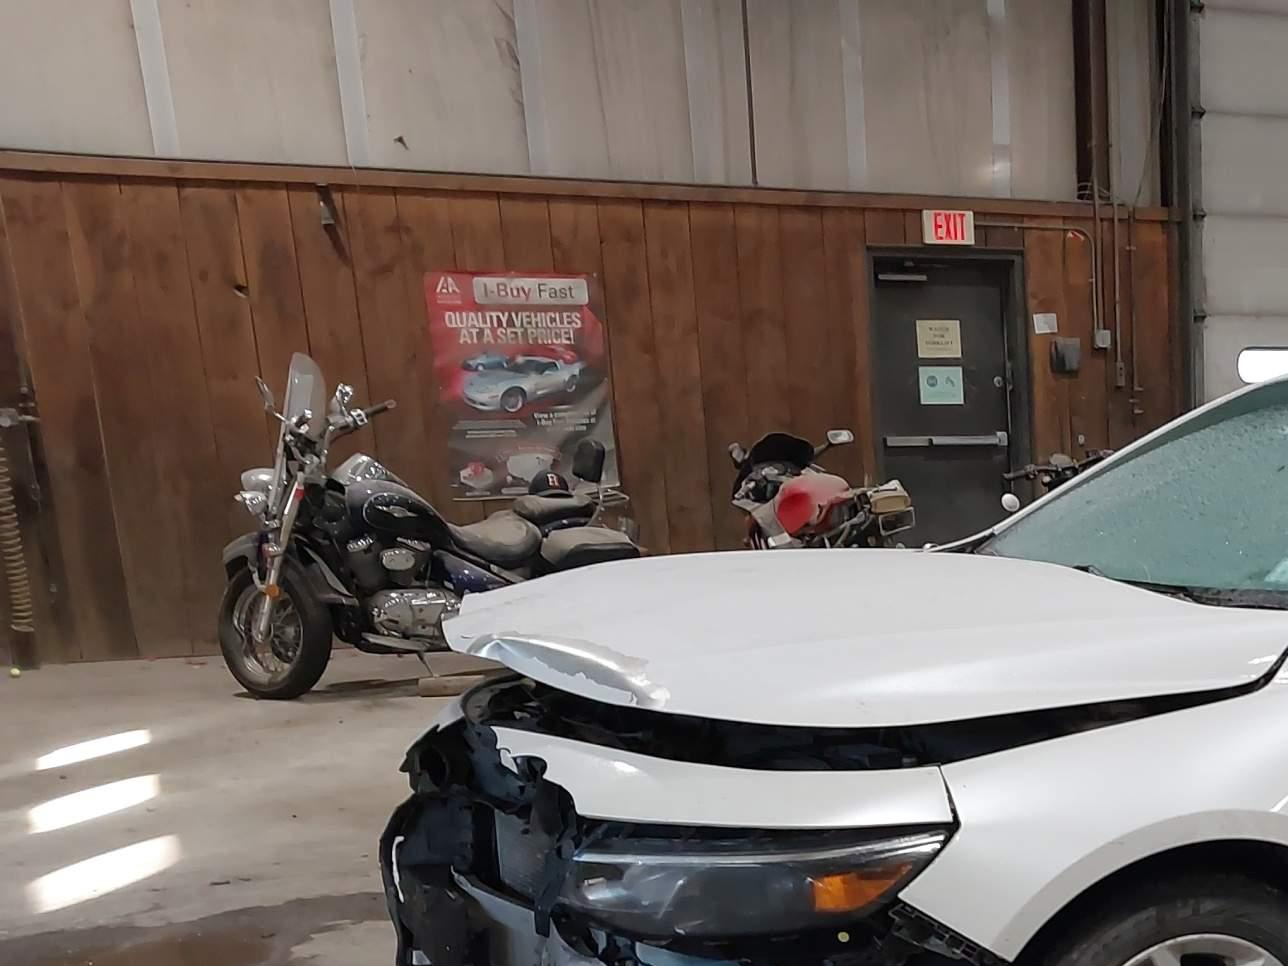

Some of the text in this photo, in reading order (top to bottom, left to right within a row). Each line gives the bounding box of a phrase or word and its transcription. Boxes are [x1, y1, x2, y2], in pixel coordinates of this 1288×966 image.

[933, 212, 966, 240] EXIT
[483, 283, 574, 300] I-Buy Fast
[445, 311, 582, 328] QUALITY VEHICLES
[459, 328, 575, 344] AT A SET PRICE!
